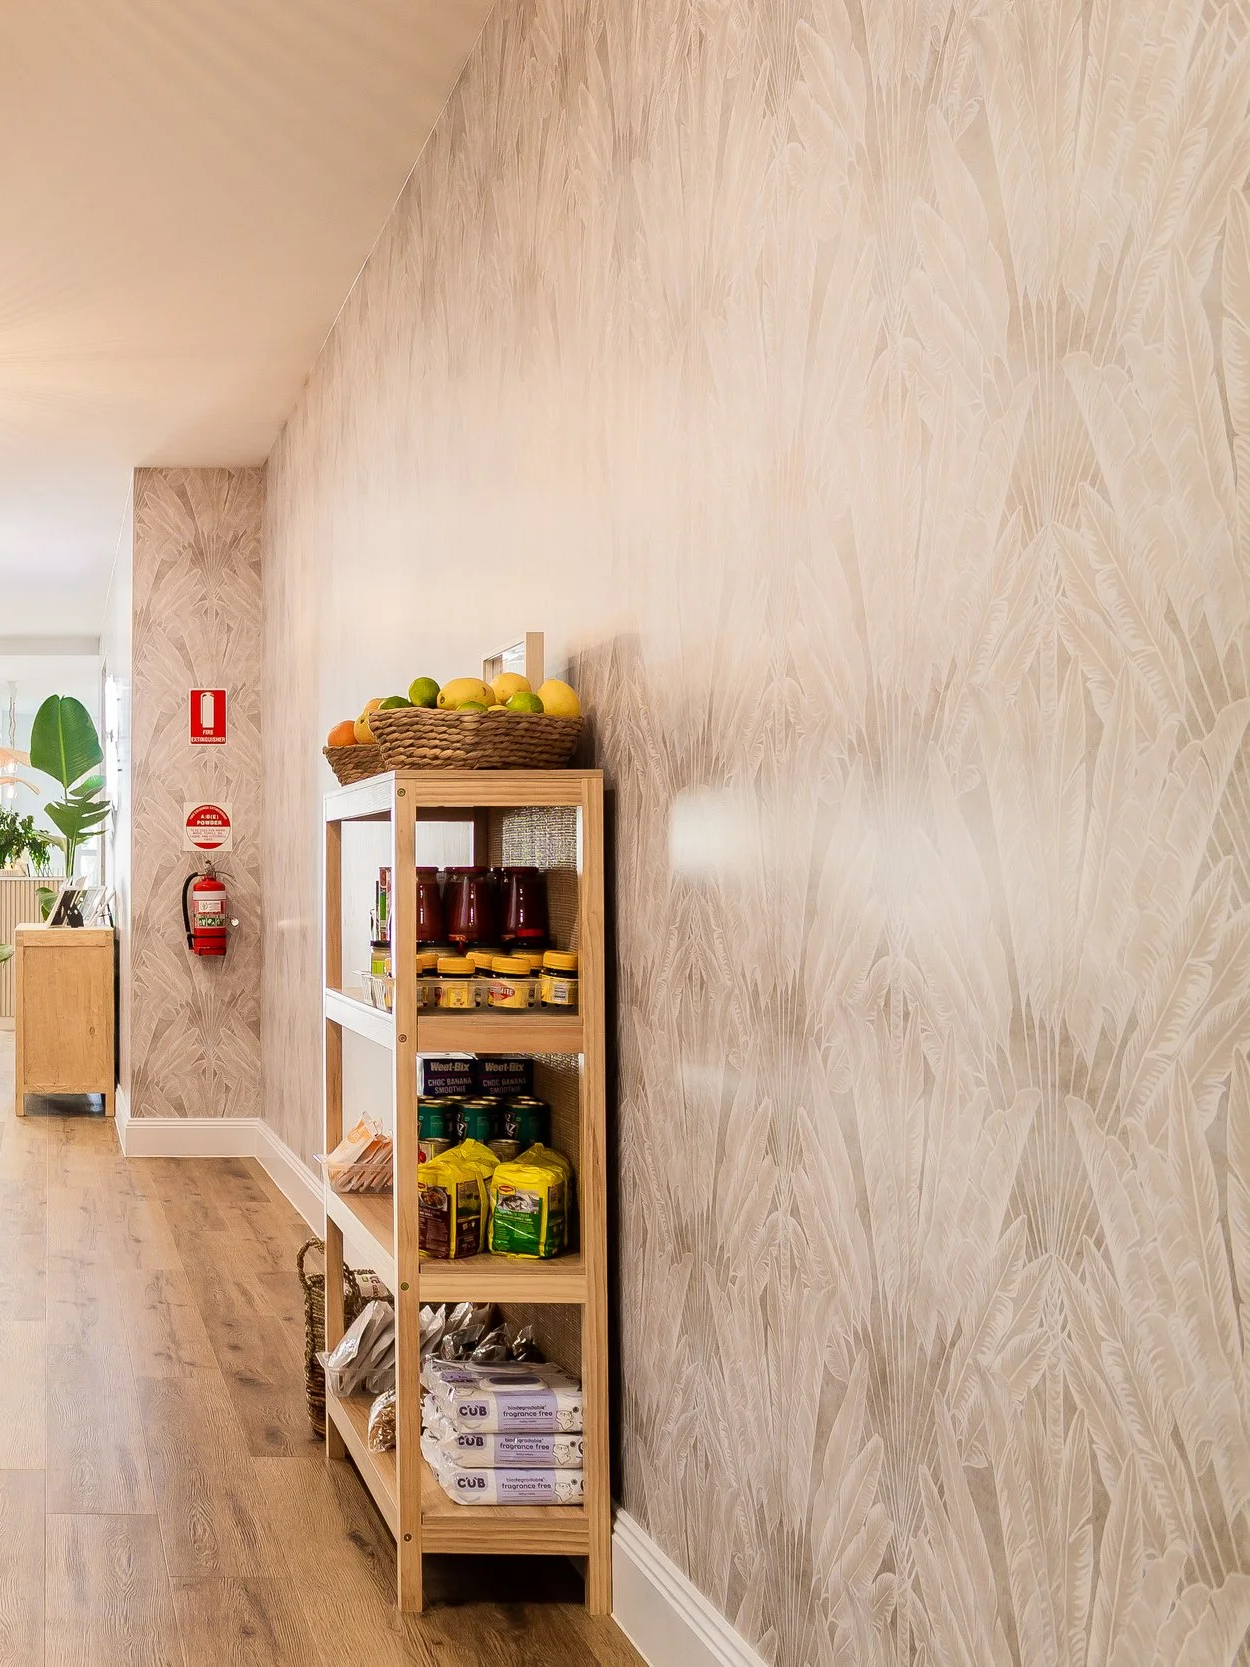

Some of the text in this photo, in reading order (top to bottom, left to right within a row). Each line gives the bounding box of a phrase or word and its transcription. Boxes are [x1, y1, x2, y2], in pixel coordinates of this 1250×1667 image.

[430, 1062, 470, 1072] Weet-Bix
[485, 1062, 524, 1072] Weet-Bix
[427, 1077, 472, 1087] CHOC BANANA
[482, 1077, 527, 1087] CHOC BANANA
[434, 1086, 466, 1095] SMOOTHIE
[489, 1086, 521, 1095] SMOOTHIE
[459, 1405, 487, 1416] CUB
[503, 1410, 537, 1418] fragrance
[458, 1435, 484, 1447] CUB
[500, 1442, 534, 1450] fragrance
[457, 1477, 486, 1488] CUB
[502, 1482, 536, 1490] fragrance
